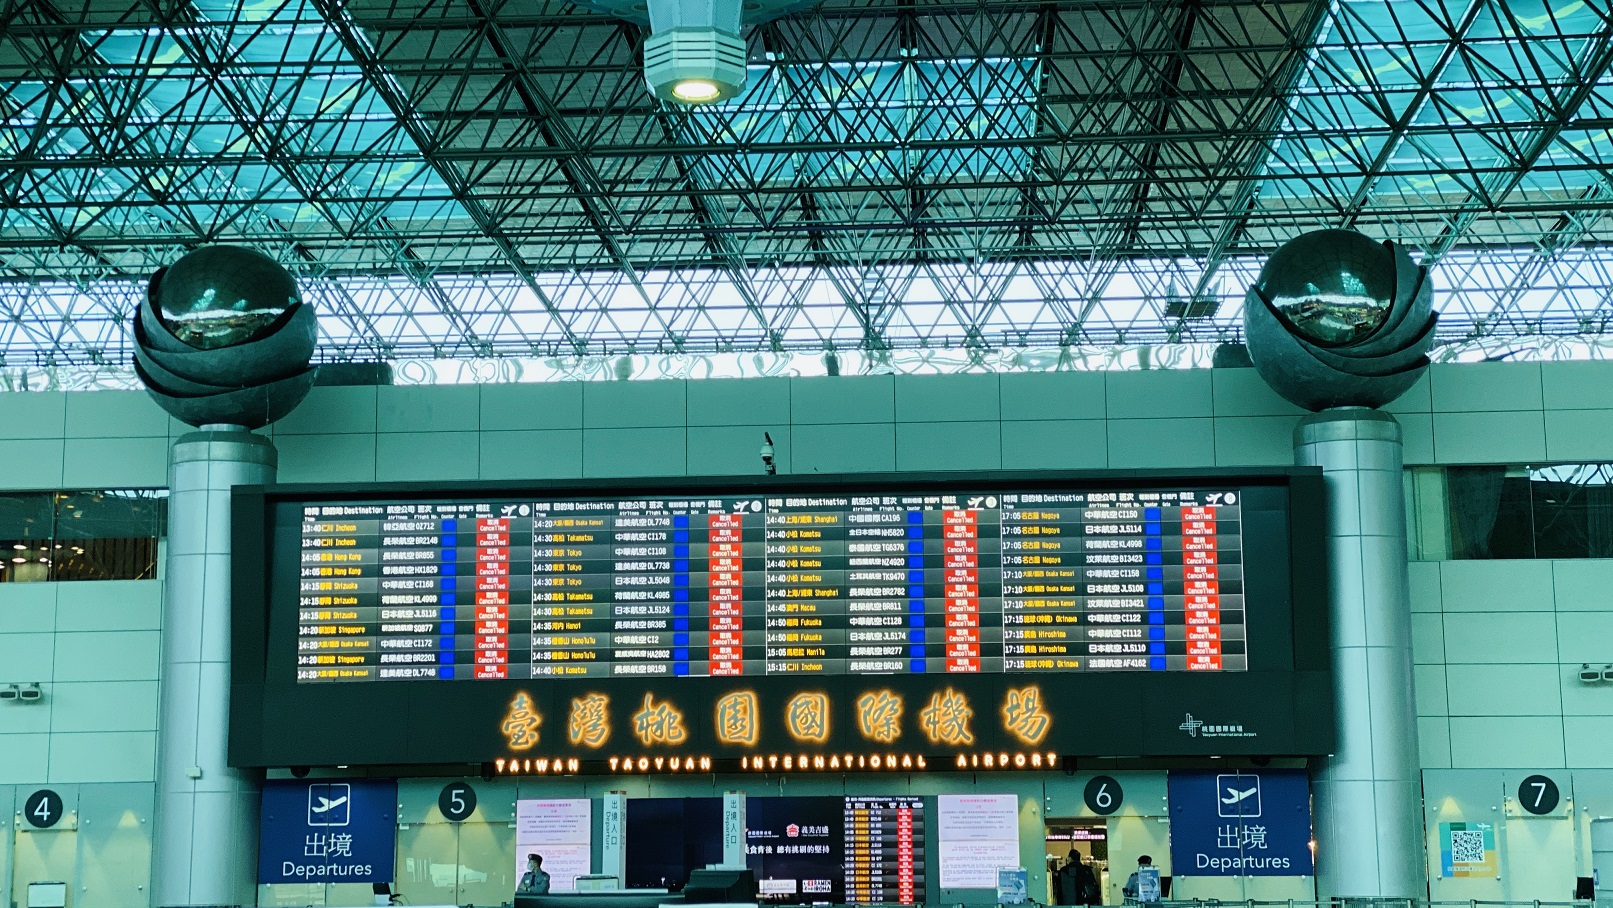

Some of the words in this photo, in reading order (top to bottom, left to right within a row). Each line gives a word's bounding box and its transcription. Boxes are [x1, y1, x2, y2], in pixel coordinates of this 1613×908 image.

[808, 498, 847, 506] Destination
[1043, 494, 1084, 502] Destination
[344, 506, 383, 514] Destination
[575, 502, 614, 510] Destination
[766, 515, 785, 524] 14:40
[1002, 512, 1021, 521] 17:05
[1117, 510, 1137, 519] CI150
[302, 524, 321, 533] 13:40
[534, 520, 552, 529] 14:20
[647, 518, 670, 527] DL7748
[767, 530, 785, 539] 14:40
[1002, 526, 1021, 535] 17:05
[1118, 524, 1141, 534] JL5114
[302, 538, 321, 547] 13:40
[534, 534, 552, 543] 14:30
[647, 532, 666, 541] CI178
[767, 545, 786, 554] 14:40
[1002, 541, 1022, 550] 17:05
[301, 553, 320, 562] 14:05
[533, 549, 552, 558] 14:30
[647, 547, 666, 556] CI108
[767, 559, 786, 568] 14:40
[881, 557, 904, 566] NZ4920
[1003, 556, 1022, 565] 17:05
[1119, 554, 1142, 563] BI3423
[301, 567, 320, 576] 14:05
[533, 563, 552, 572] 14:30
[767, 574, 786, 583] 14:40
[881, 572, 905, 581] TK9470
[1003, 570, 1022, 579] 17:10
[300, 582, 319, 591] 14:15
[533, 578, 552, 587] 14:30
[767, 589, 786, 598] 14:40
[1003, 585, 1023, 594] 17:10
[300, 597, 319, 606] 14:15
[533, 593, 552, 602] 14:30
[767, 603, 786, 612] 14:45
[1004, 600, 1023, 609] 17:10
[1120, 598, 1144, 608] BI3421
[533, 607, 552, 616] 14:30
[647, 605, 669, 615] JL5124
[300, 611, 319, 621] 14:15
[1004, 615, 1023, 624] 17:15
[1121, 613, 1141, 623] CI122
[533, 622, 552, 631] 14:35
[767, 618, 786, 627] 14:50
[299, 626, 318, 635] 14:20
[1004, 630, 1024, 639] 17:15
[1121, 628, 1141, 638] CI112
[533, 637, 552, 646] 14:35
[646, 635, 658, 645] CI2
[767, 633, 786, 642] 14:50
[882, 631, 906, 641] JL5174
[299, 641, 318, 650] 14:20
[413, 639, 432, 648] CI172
[1005, 645, 1024, 654] 17:15
[1122, 643, 1146, 653] JL5110
[533, 651, 551, 660] 14:35
[767, 648, 786, 657] 15:05
[882, 646, 902, 656] BR277
[298, 655, 317, 665] 14:20
[1005, 660, 1024, 669] 17:15
[532, 666, 551, 675] 14:40
[768, 662, 786, 672] 15:15
[298, 670, 317, 679] 14:20
[501, 688, 1051, 748] 臺灣桃園國際機場
[496, 758, 579, 773] TAIWAN
[609, 757, 712, 772] TAOYUAN
[741, 755, 926, 771] INTERNATIONAL
[956, 752, 1058, 768] AIRPORT
[1096, 783, 1112, 808] 6
[1531, 782, 1546, 807] 7
[450, 789, 465, 814] 5
[34, 796, 51, 821] 4
[801, 825, 829, 834] 義美吉盛
[1217, 824, 1268, 850] 出境
[303, 832, 353, 858] 出境
[1196, 853, 1290, 872] Departures
[282, 861, 373, 880] Departures
